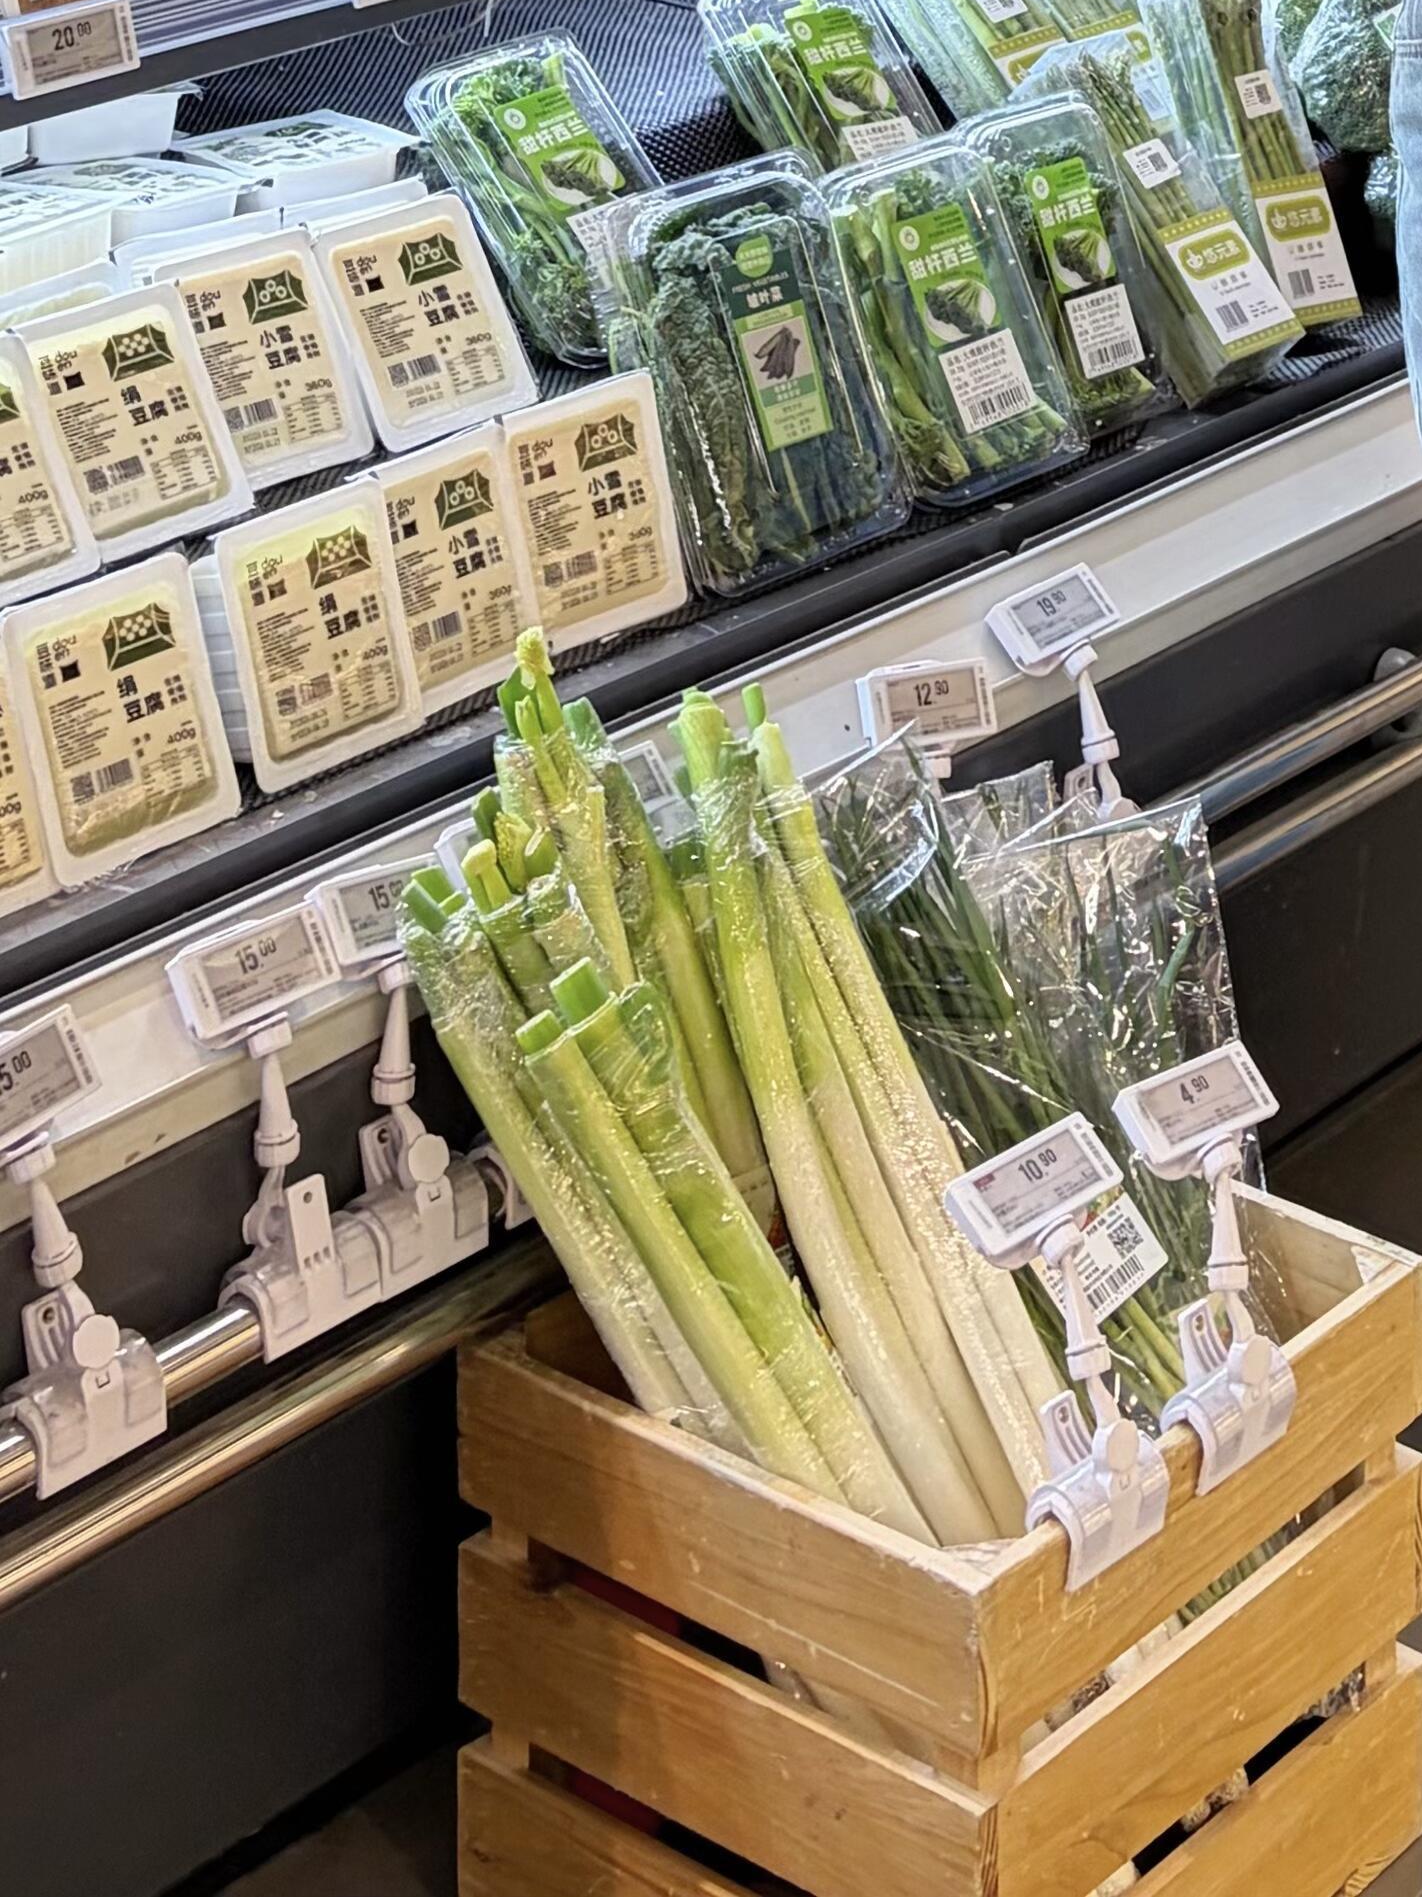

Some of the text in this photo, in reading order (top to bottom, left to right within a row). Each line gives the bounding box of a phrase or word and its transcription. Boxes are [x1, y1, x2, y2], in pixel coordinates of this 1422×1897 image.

[52, 21, 92, 52] 20.00
[908, 244, 977, 280] 甜杆西兰
[265, 346, 302, 370] 豆腐
[128, 400, 169, 426] 豆腐
[591, 492, 628, 520] 豆腐
[452, 550, 487, 579] 豆腐
[324, 609, 361, 640] 豆腐
[123, 691, 165, 724] 豆腐
[167, 728, 196, 744] 400g
[235, 937, 278, 974] 15.00
[1179, 1075, 1210, 1106] 4.90
[1018, 1148, 1057, 1182] 10.90
